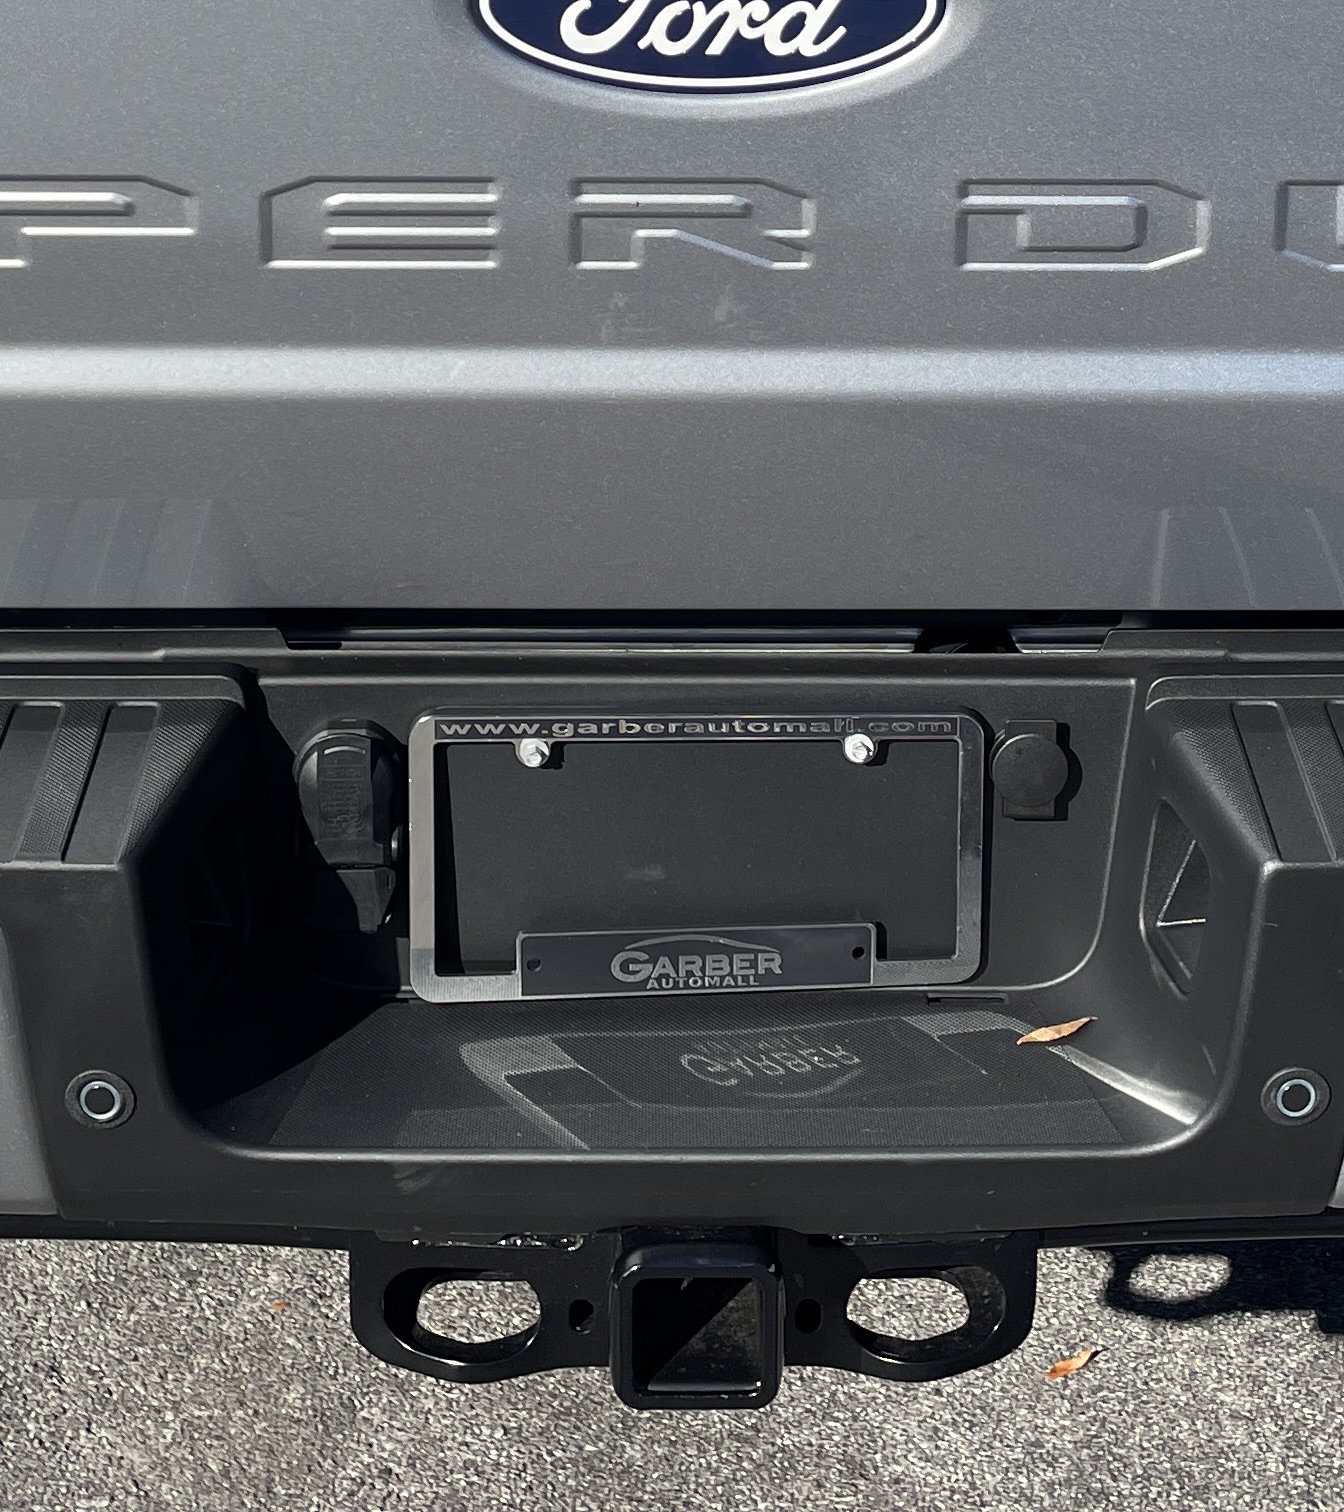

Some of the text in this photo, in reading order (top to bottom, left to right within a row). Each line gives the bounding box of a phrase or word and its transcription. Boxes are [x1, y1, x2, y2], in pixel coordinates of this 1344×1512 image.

[440, 717, 952, 737] www.garberautomall.com
[611, 950, 782, 983] GARBER
[646, 975, 759, 989] AUTOMALL
